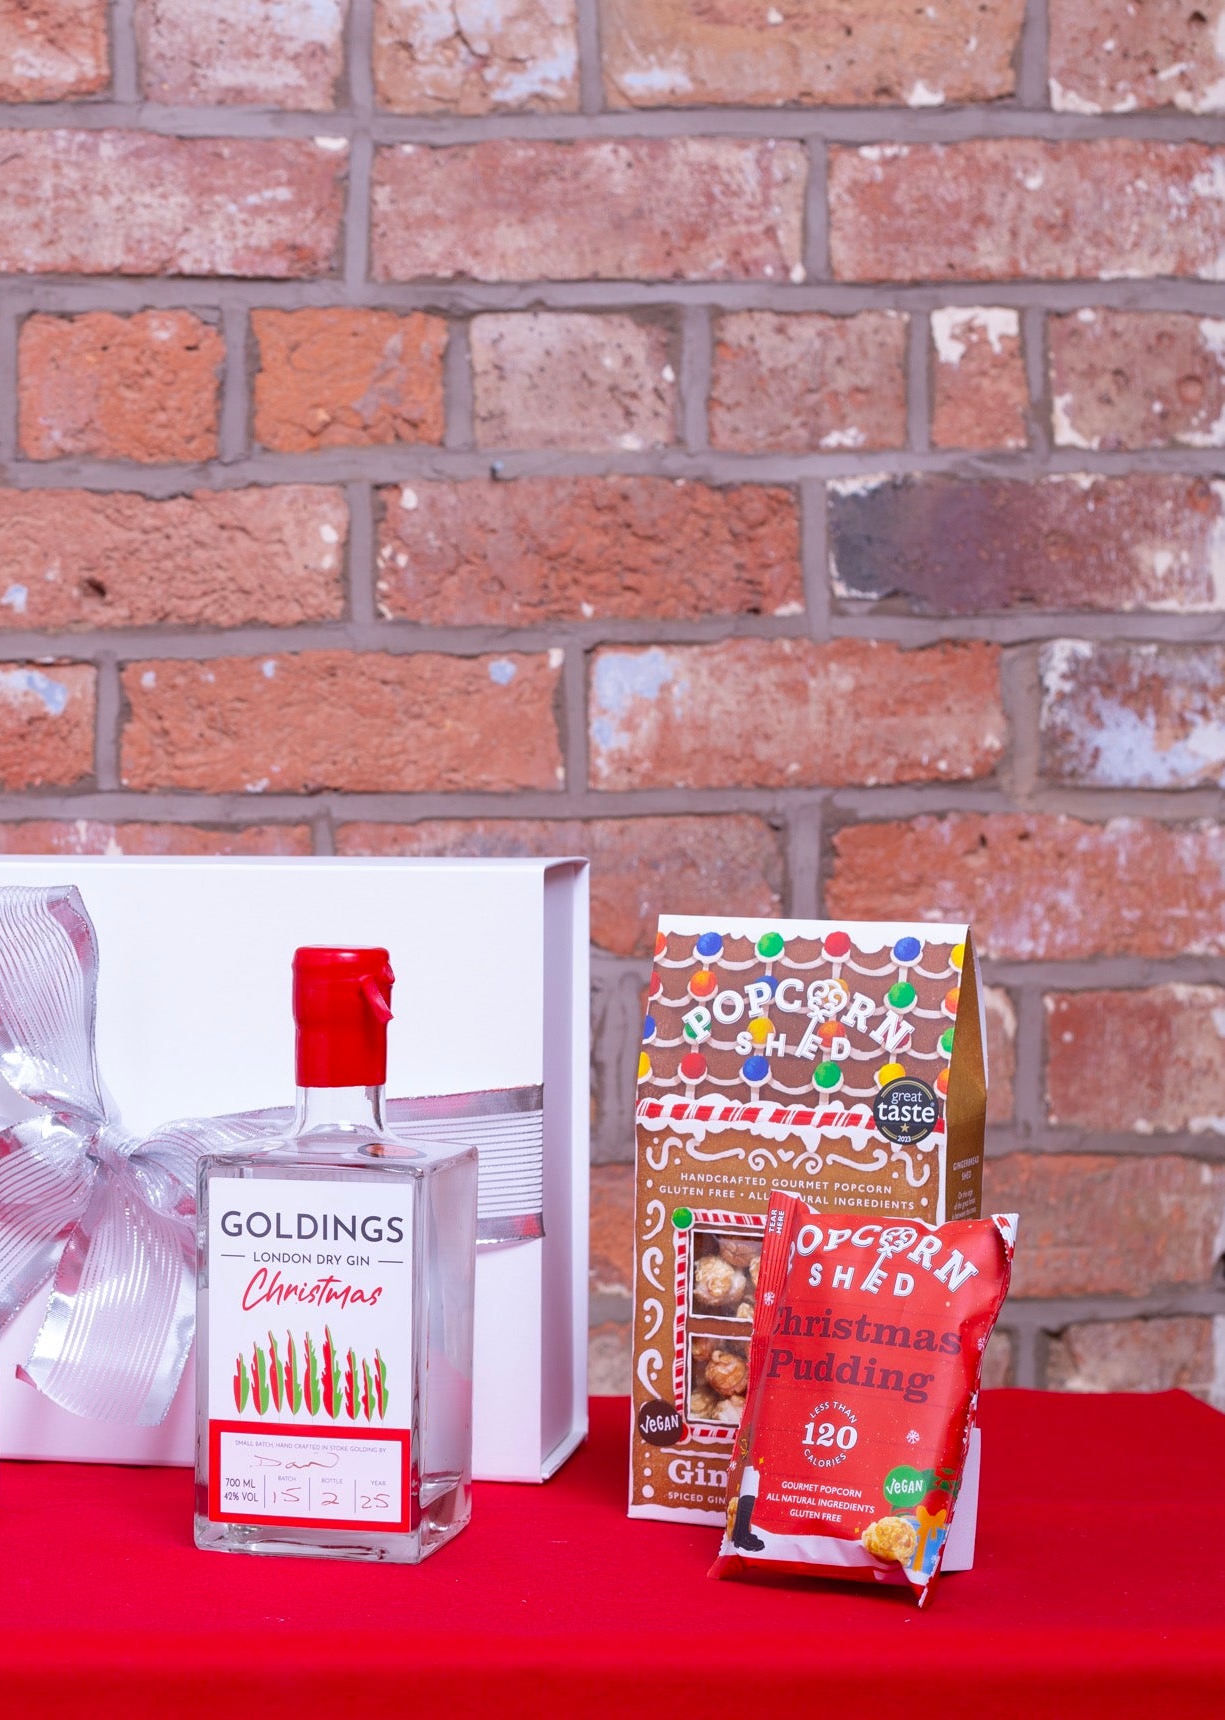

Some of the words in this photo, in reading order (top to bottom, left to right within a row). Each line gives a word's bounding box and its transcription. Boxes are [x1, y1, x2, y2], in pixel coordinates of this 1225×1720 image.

[681, 978, 915, 1053] POPCORN
[735, 1030, 852, 1062] SHED
[891, 1092, 922, 1105] great
[877, 1102, 935, 1123] taste
[681, 1172, 766, 1187] HANDCRAFTED
[772, 1178, 829, 1191] GOURMET
[834, 1182, 893, 1195] POPCORN
[659, 1185, 700, 1197] GLUTEN
[704, 1188, 736, 1200] FREE
[748, 1190, 770, 1201] ALL
[799, 1194, 829, 1205] URAL
[834, 1197, 915, 1210] INGREDIENTS
[221, 1210, 404, 1243] GOLDINGS
[768, 1209, 778, 1233] TEAR
[776, 1210, 785, 1234] HERE
[253, 1252, 312, 1264] LONDON
[317, 1254, 342, 1265] DRY
[346, 1255, 370, 1266] GIN
[242, 1267, 382, 1311] Christmas
[808, 1262, 915, 1297] SHED
[767, 1349, 935, 1404] Pudding
[810, 1401, 829, 1419] LESS
[833, 1401, 857, 1424] THAN
[801, 1422, 858, 1450] 120
[804, 1449, 847, 1468] CALORIES
[225, 1478, 240, 1488] 700
[243, 1479, 256, 1489] ML
[781, 1481, 819, 1493] GOURMET
[820, 1485, 862, 1498] POPCORN
[224, 1492, 240, 1501] 42%
[241, 1492, 258, 1502] VOL
[322, 1492, 339, 1505] 2
[667, 1491, 704, 1503] SPICED
[766, 1493, 781, 1503] ALL
[781, 1495, 816, 1506] NATURAL
[818, 1499, 875, 1514] INGREDIENTS
[790, 1509, 821, 1520] GLUTEN
[822, 1512, 842, 1523] FREE
